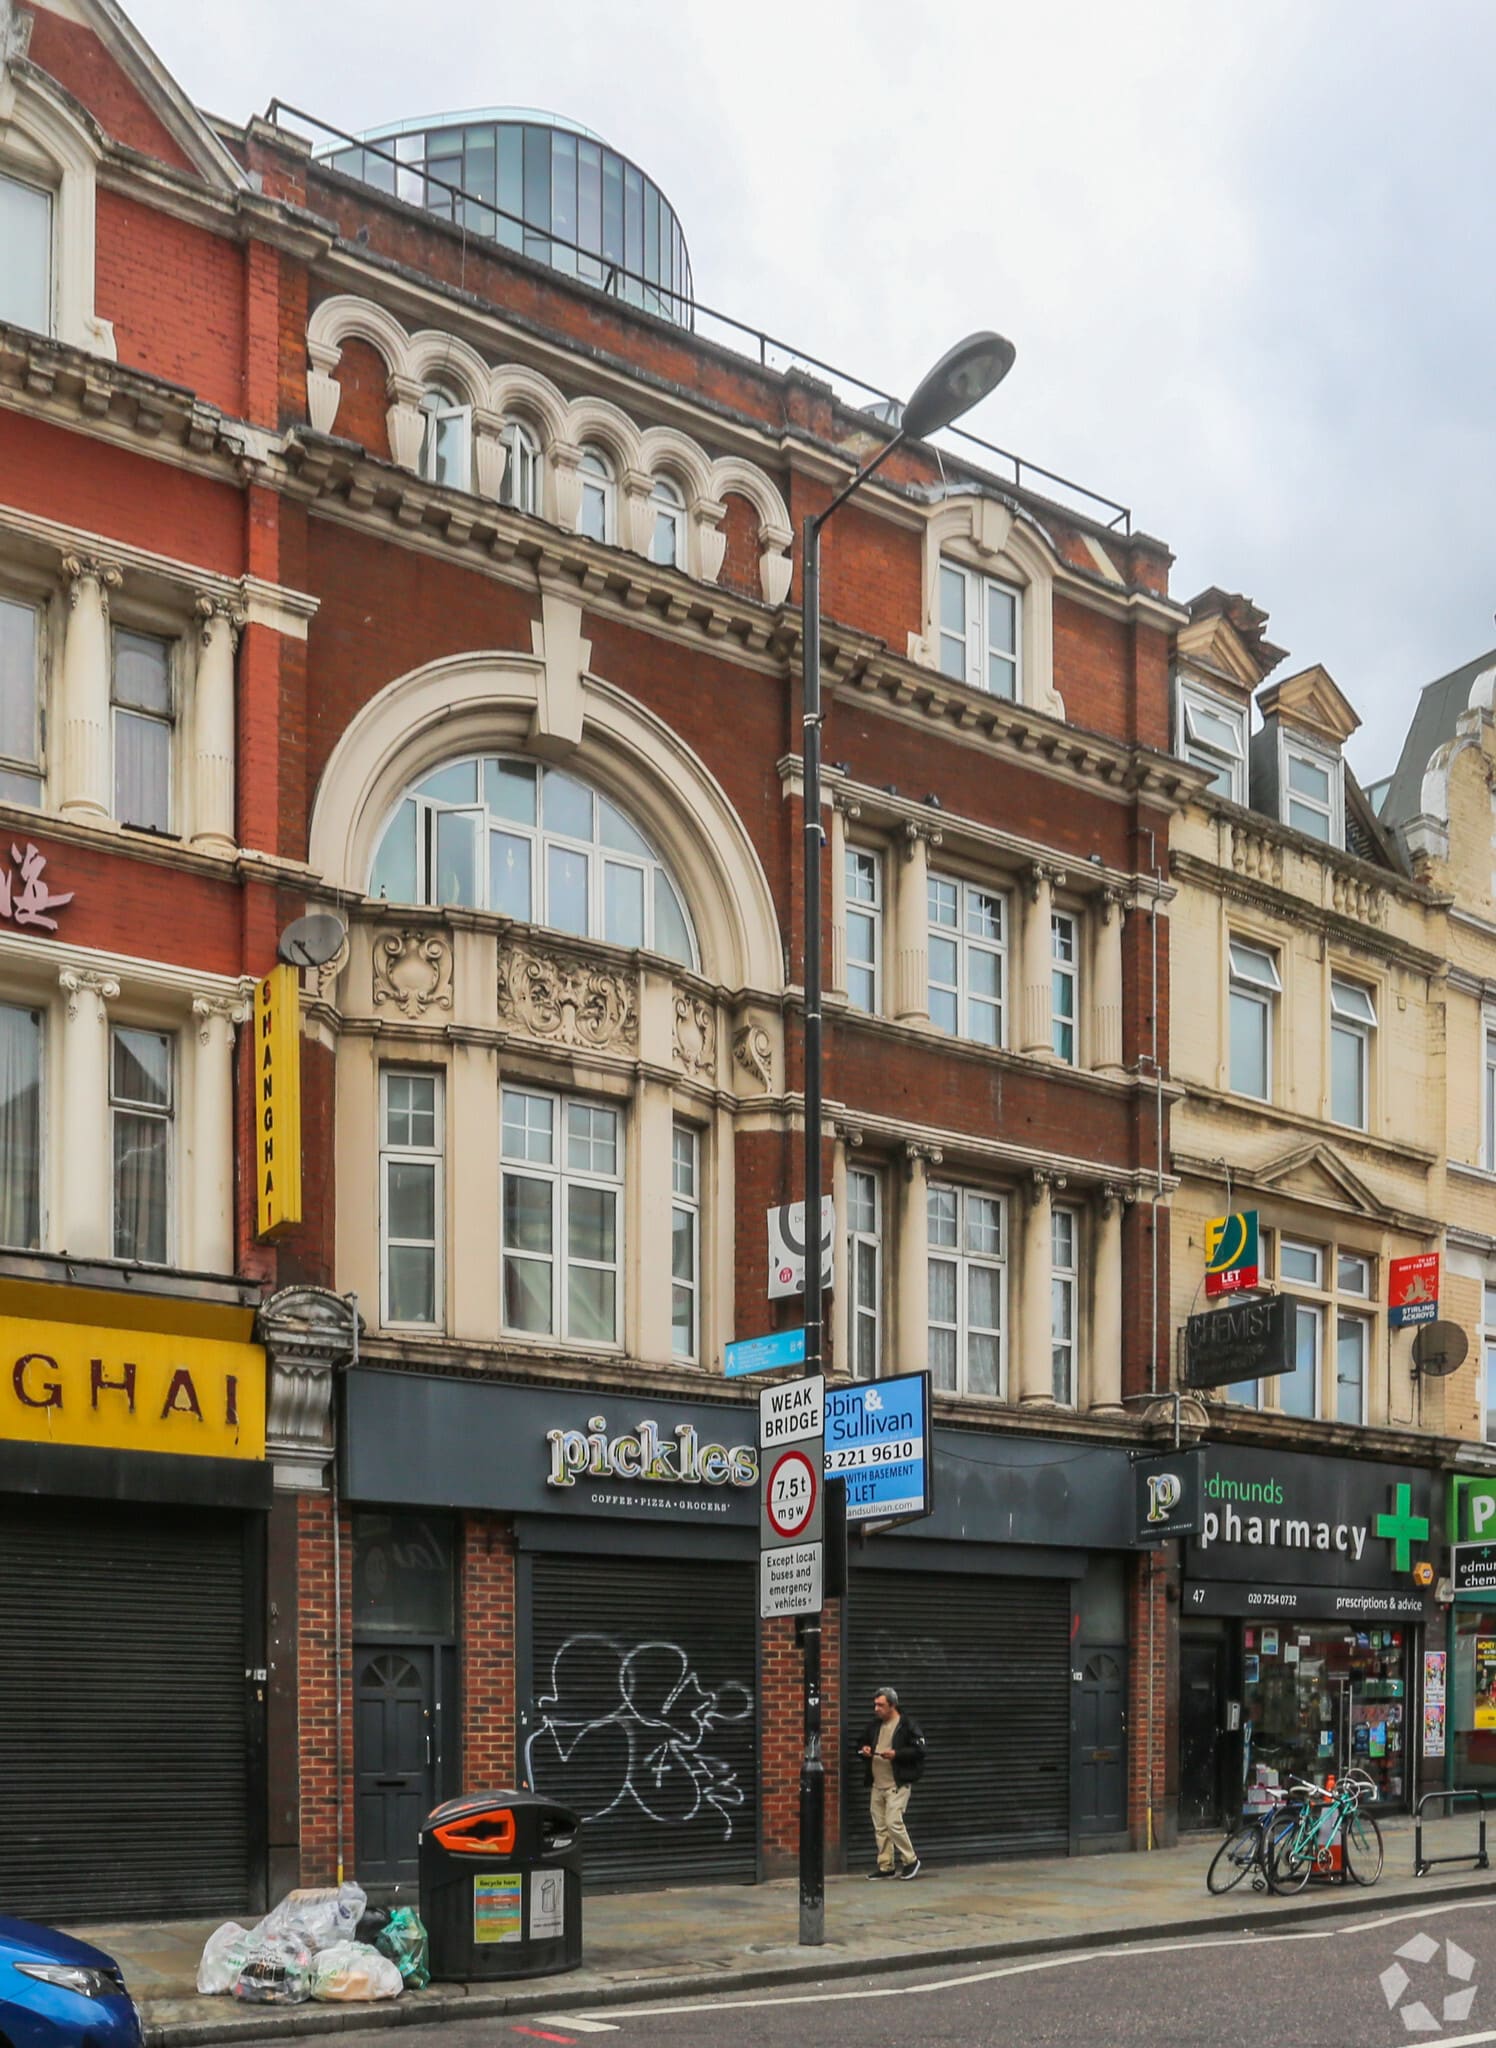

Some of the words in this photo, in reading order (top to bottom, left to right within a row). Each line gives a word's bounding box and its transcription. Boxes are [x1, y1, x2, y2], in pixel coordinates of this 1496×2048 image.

[262, 979, 274, 1226] SHANGHAI
[1221, 1269, 1241, 1283] LET
[1402, 1303, 1435, 1315] STIRLING
[1188, 1302, 1277, 1349] CHEMIST
[771, 1387, 812, 1414] WEAK
[864, 1389, 884, 1412] &
[766, 1409, 819, 1438] BRIDGE
[833, 1410, 913, 1441] Sullivan
[546, 1415, 760, 1487] pickles
[838, 1448, 867, 1468] 221
[872, 1441, 913, 1462] 9610
[845, 1471, 867, 1485] WITH
[869, 1464, 914, 1482] BASEMENT
[855, 1483, 877, 1503] LET
[1204, 1472, 1284, 1505] dmunds
[591, 1494, 633, 1506] COFFEE
[640, 1497, 672, 1509] PIZZA
[1201, 1503, 1367, 1561] pharmacy
[767, 1554, 794, 1568] Except
[796, 1549, 817, 1564] local
[771, 1569, 794, 1581] buses
[796, 1565, 811, 1578] and
[769, 1582, 813, 1596] emergency
[1193, 1589, 1205, 1603] 47
[1248, 1593, 1262, 1604] 020
[1263, 1594, 1279, 1605] 7254
[1280, 1594, 1297, 1606] 0732
[1336, 1595, 1388, 1612] prescriptions
[1389, 1596, 1397, 1610] &
[1398, 1598, 1423, 1612] advice
[775, 1596, 807, 1609] vehicles
